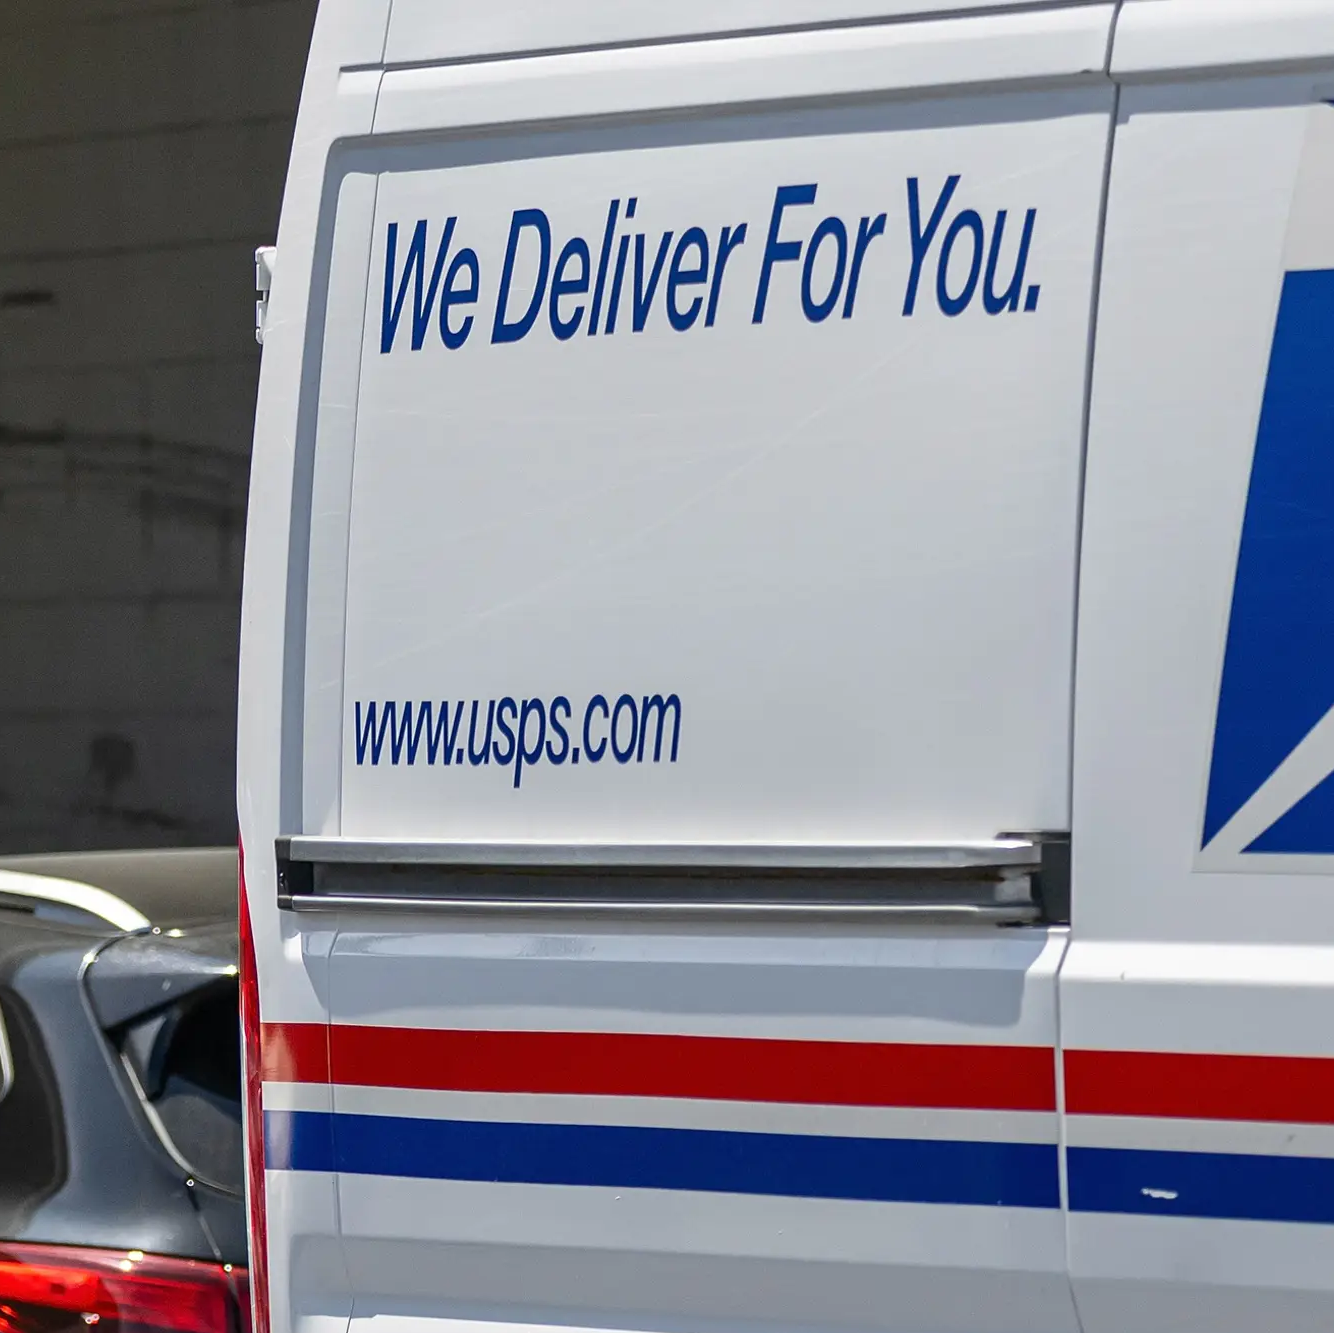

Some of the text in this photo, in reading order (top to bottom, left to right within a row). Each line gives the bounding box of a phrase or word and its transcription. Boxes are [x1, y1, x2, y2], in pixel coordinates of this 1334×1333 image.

[380, 175, 1041, 354] We Deliver For You.
[353, 693, 683, 788] www.usps.com
